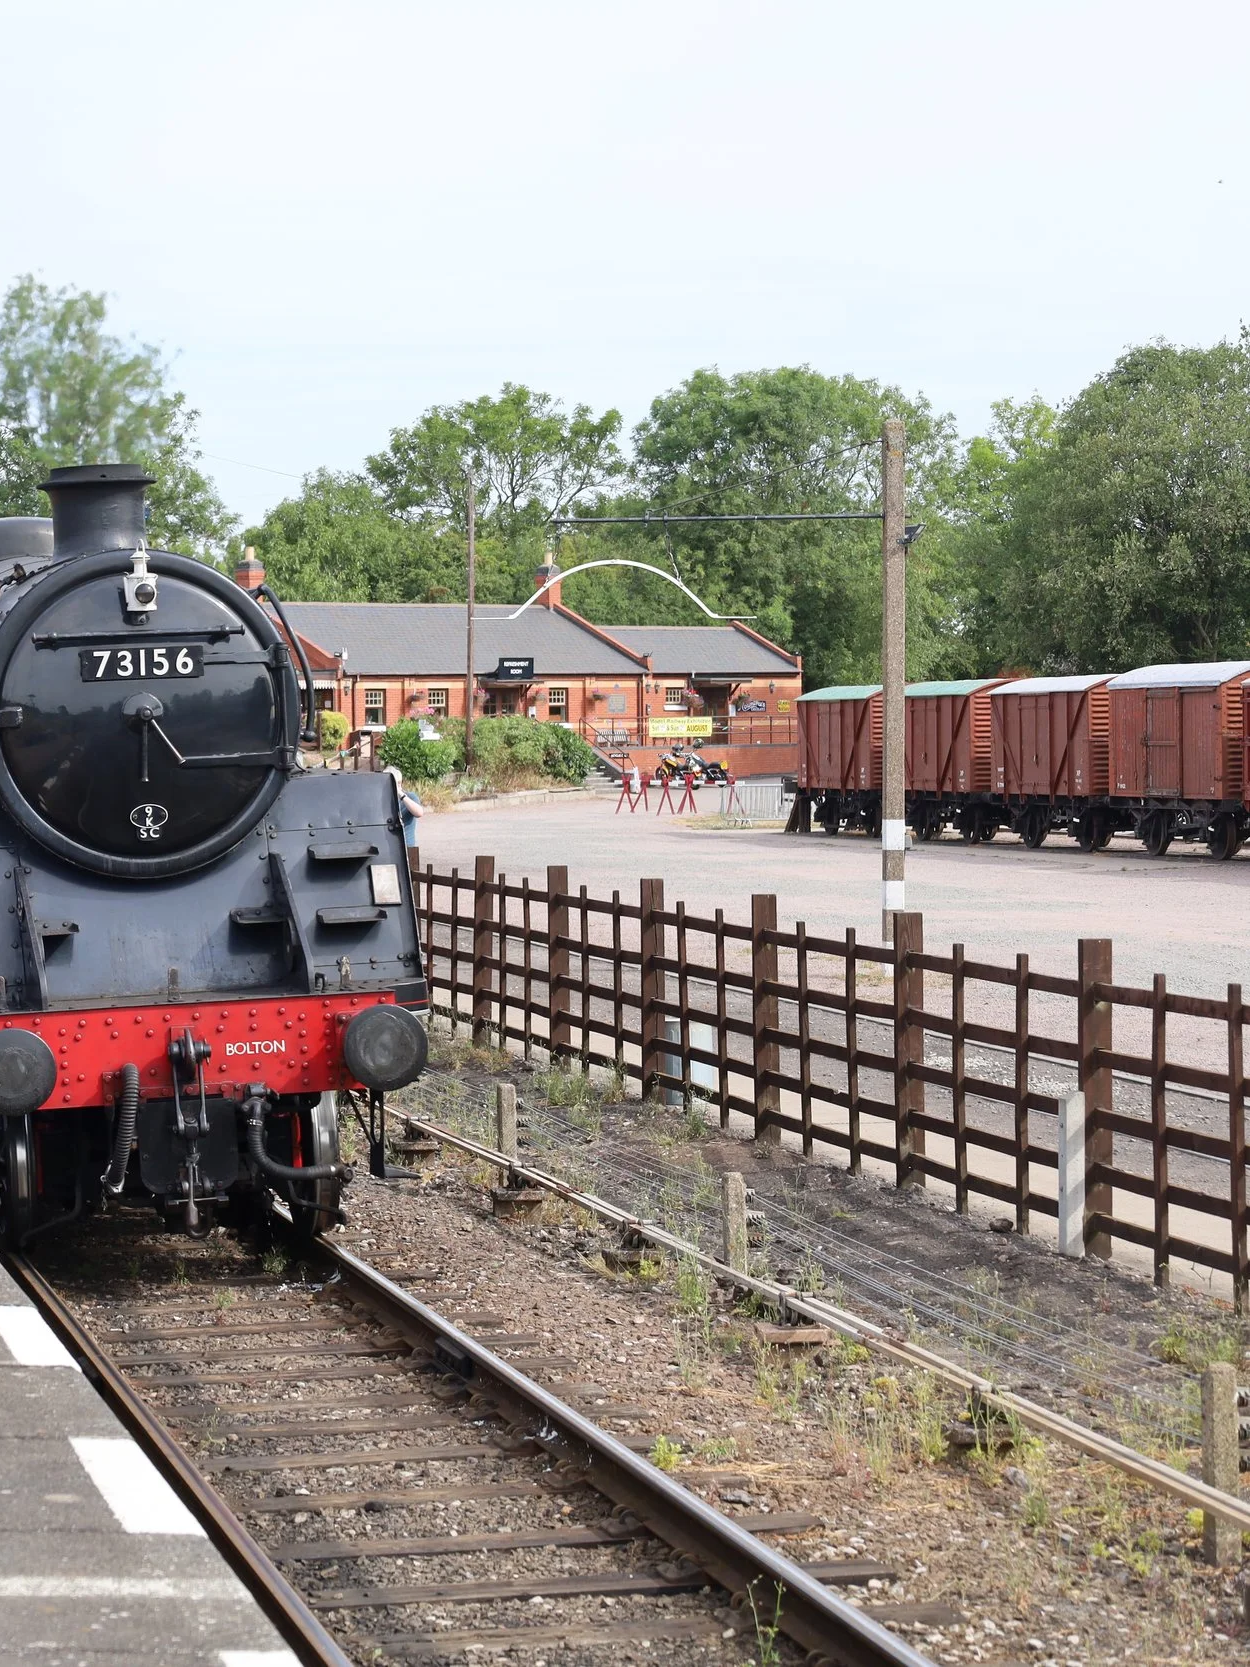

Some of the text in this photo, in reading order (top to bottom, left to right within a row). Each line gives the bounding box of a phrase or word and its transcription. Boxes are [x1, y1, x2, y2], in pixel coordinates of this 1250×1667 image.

[92, 647, 195, 678] 73156
[145, 806, 153, 817] 9
[145, 817, 154, 828] K
[139, 827, 160, 839] SC
[225, 1039, 286, 1056] BOLTON
